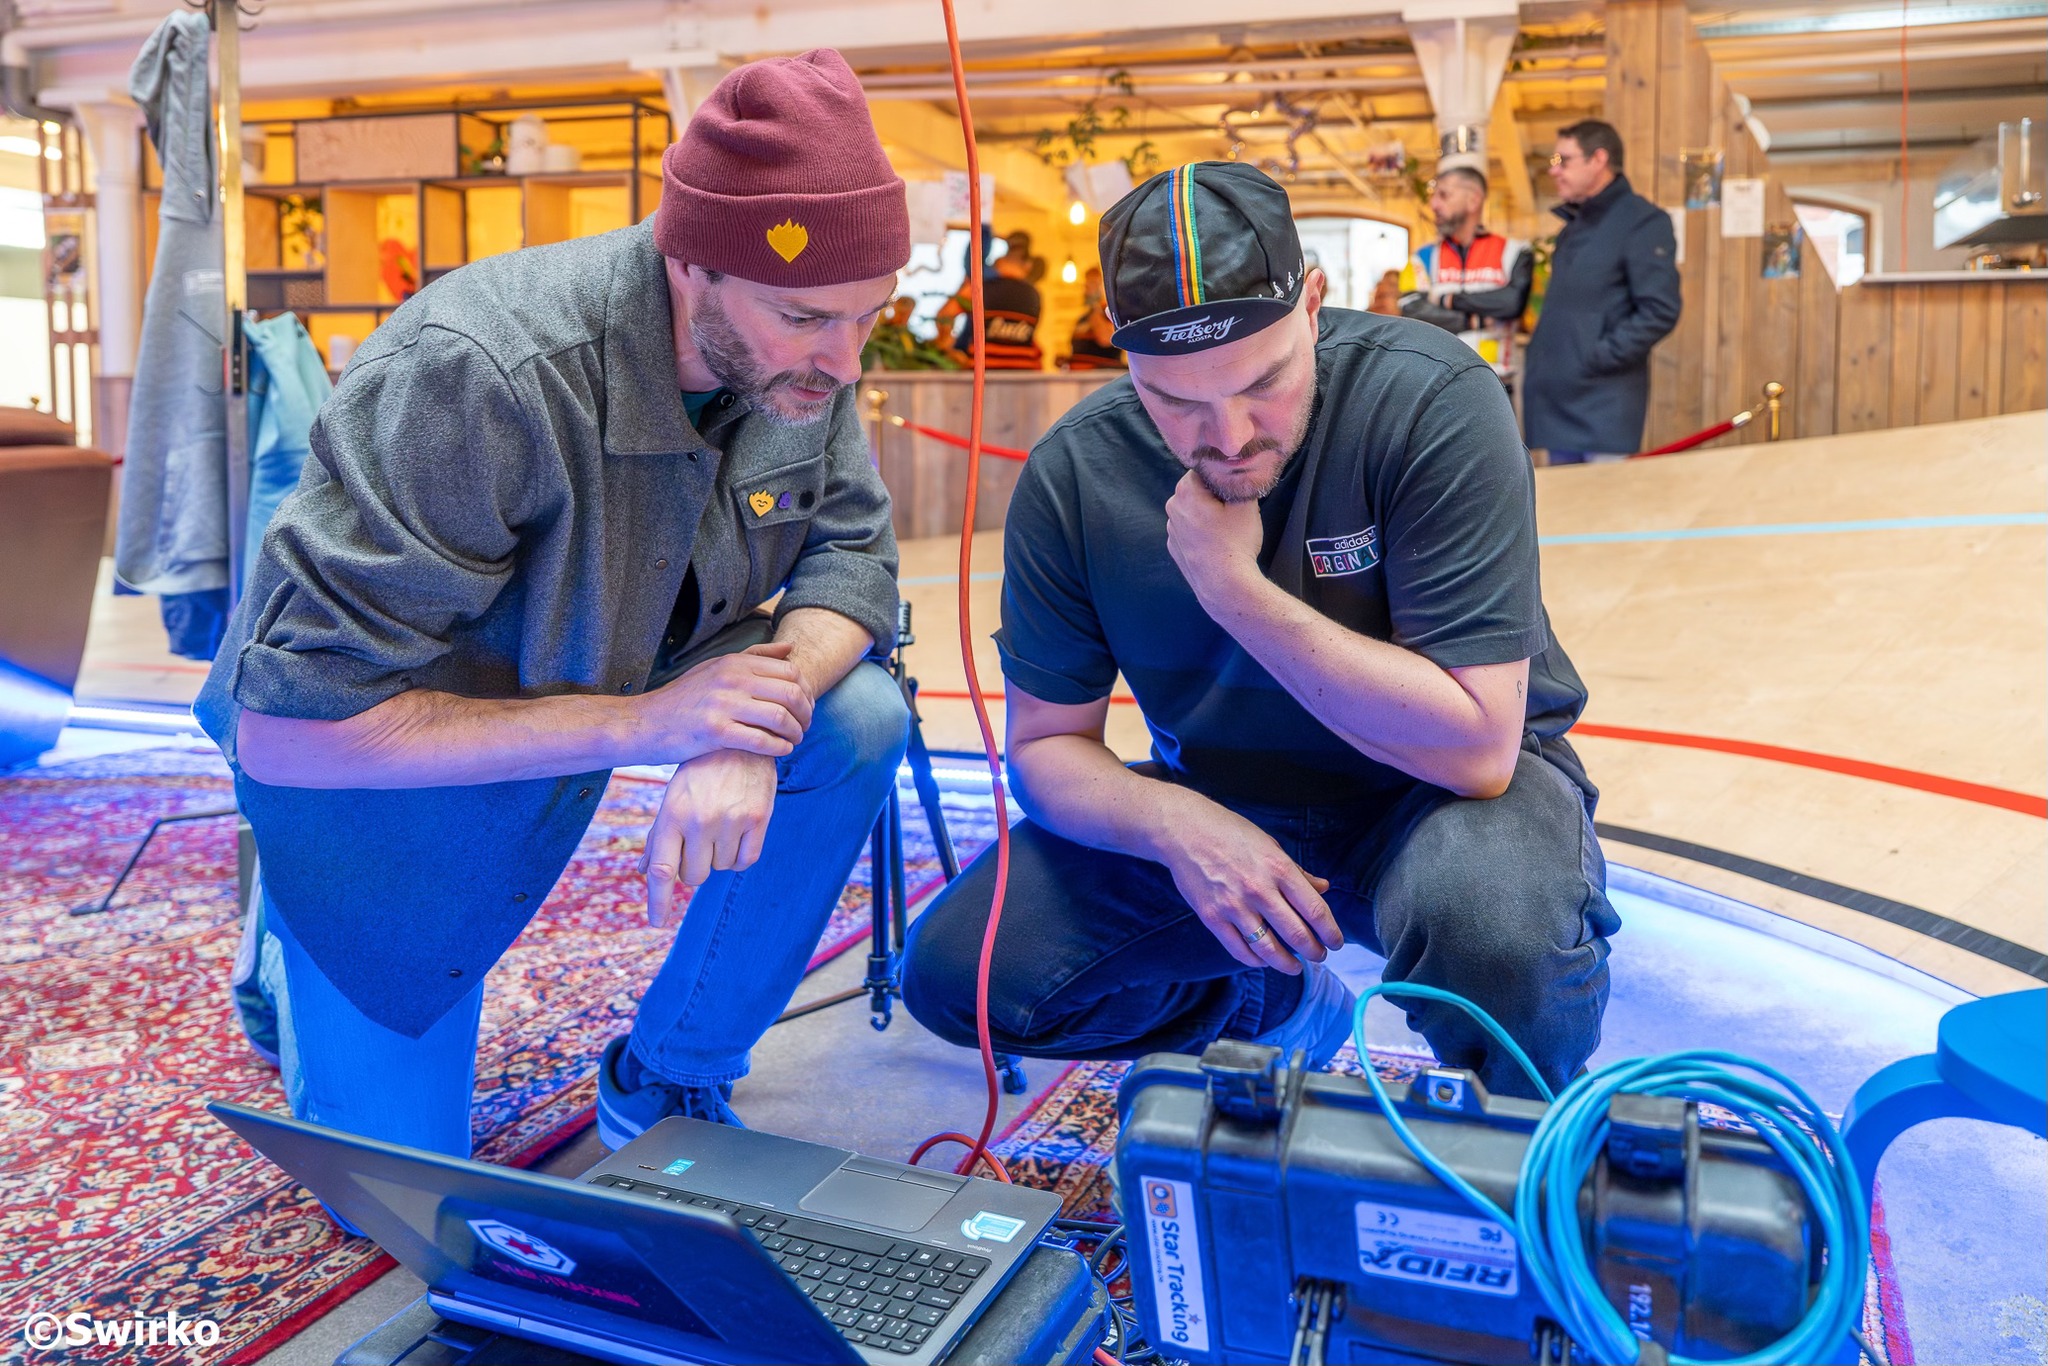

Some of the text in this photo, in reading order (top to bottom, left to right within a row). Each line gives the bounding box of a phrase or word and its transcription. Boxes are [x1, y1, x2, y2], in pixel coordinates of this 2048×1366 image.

[1150, 315, 1243, 342] Fietsery
[1334, 534, 1370, 550] adidas
[1161, 1220, 1189, 1343] Star Tracking
